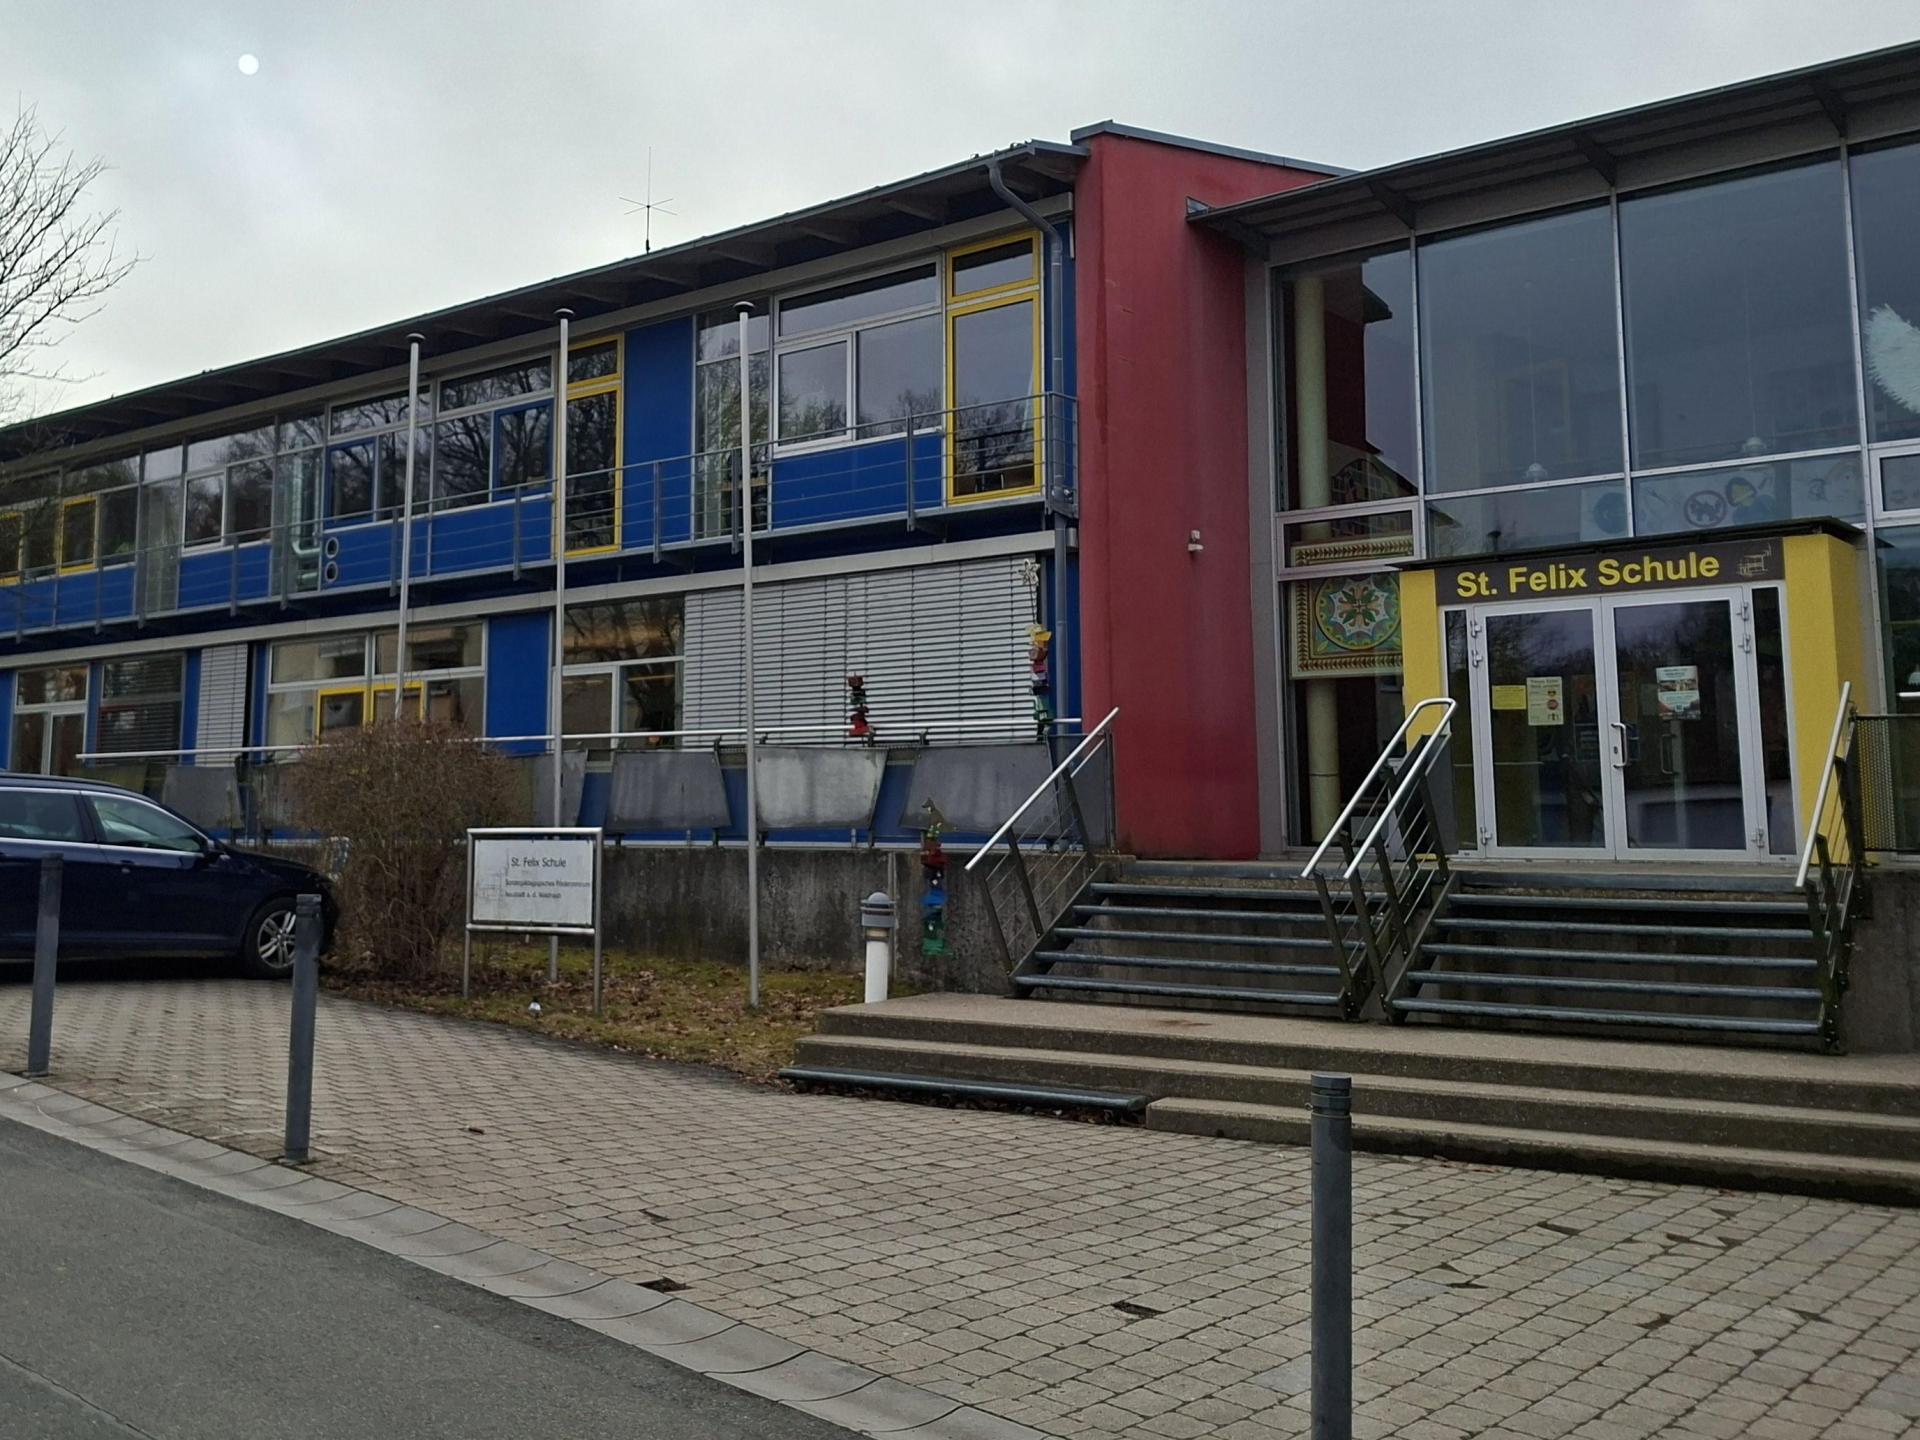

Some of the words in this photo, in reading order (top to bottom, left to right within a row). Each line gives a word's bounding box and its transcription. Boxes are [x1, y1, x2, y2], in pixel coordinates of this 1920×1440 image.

[1456, 571, 1498, 598] St.
[1508, 563, 1587, 593] Felix
[1597, 551, 1720, 587] Schule
[511, 857, 521, 867] St.
[523, 856, 540, 867] Felix
[542, 856, 566, 868] Schule
